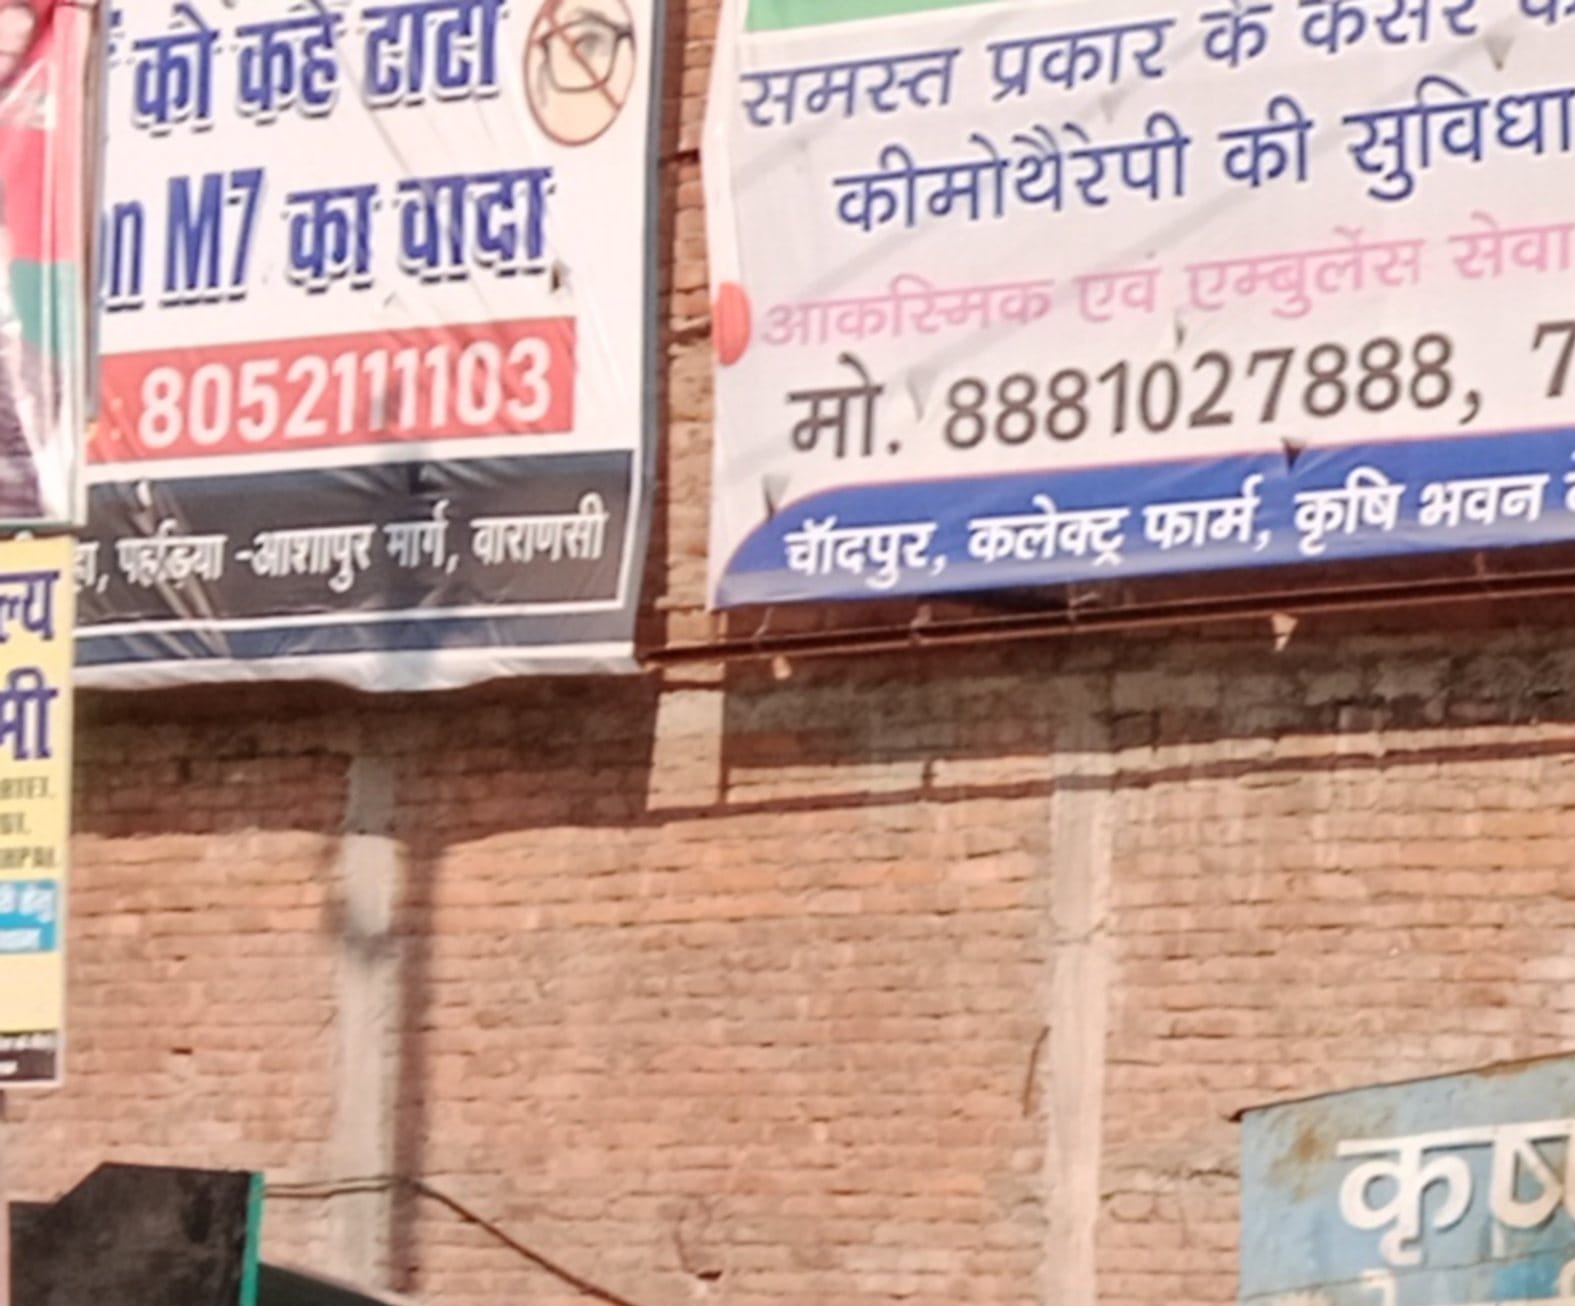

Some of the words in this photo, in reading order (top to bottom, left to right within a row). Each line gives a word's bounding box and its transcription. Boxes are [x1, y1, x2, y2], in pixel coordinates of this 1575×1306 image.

[740, 48, 960, 129] समस्त
[987, 18, 1176, 101] प्रकार
[1219, 97, 1313, 189] की
[164, 167, 265, 296] M7
[286, 184, 378, 281] का
[397, 167, 553, 275] वादा
[760, 273, 1055, 346] आकस्मिक
[1073, 250, 1164, 324] एवं
[1449, 210, 1575, 281] सेवा
[138, 336, 553, 449] 8052111103
[470, 491, 610, 566] वाराणसी
[1292, 465, 1403, 557] कृषि
[1416, 470, 1549, 531] भवन
